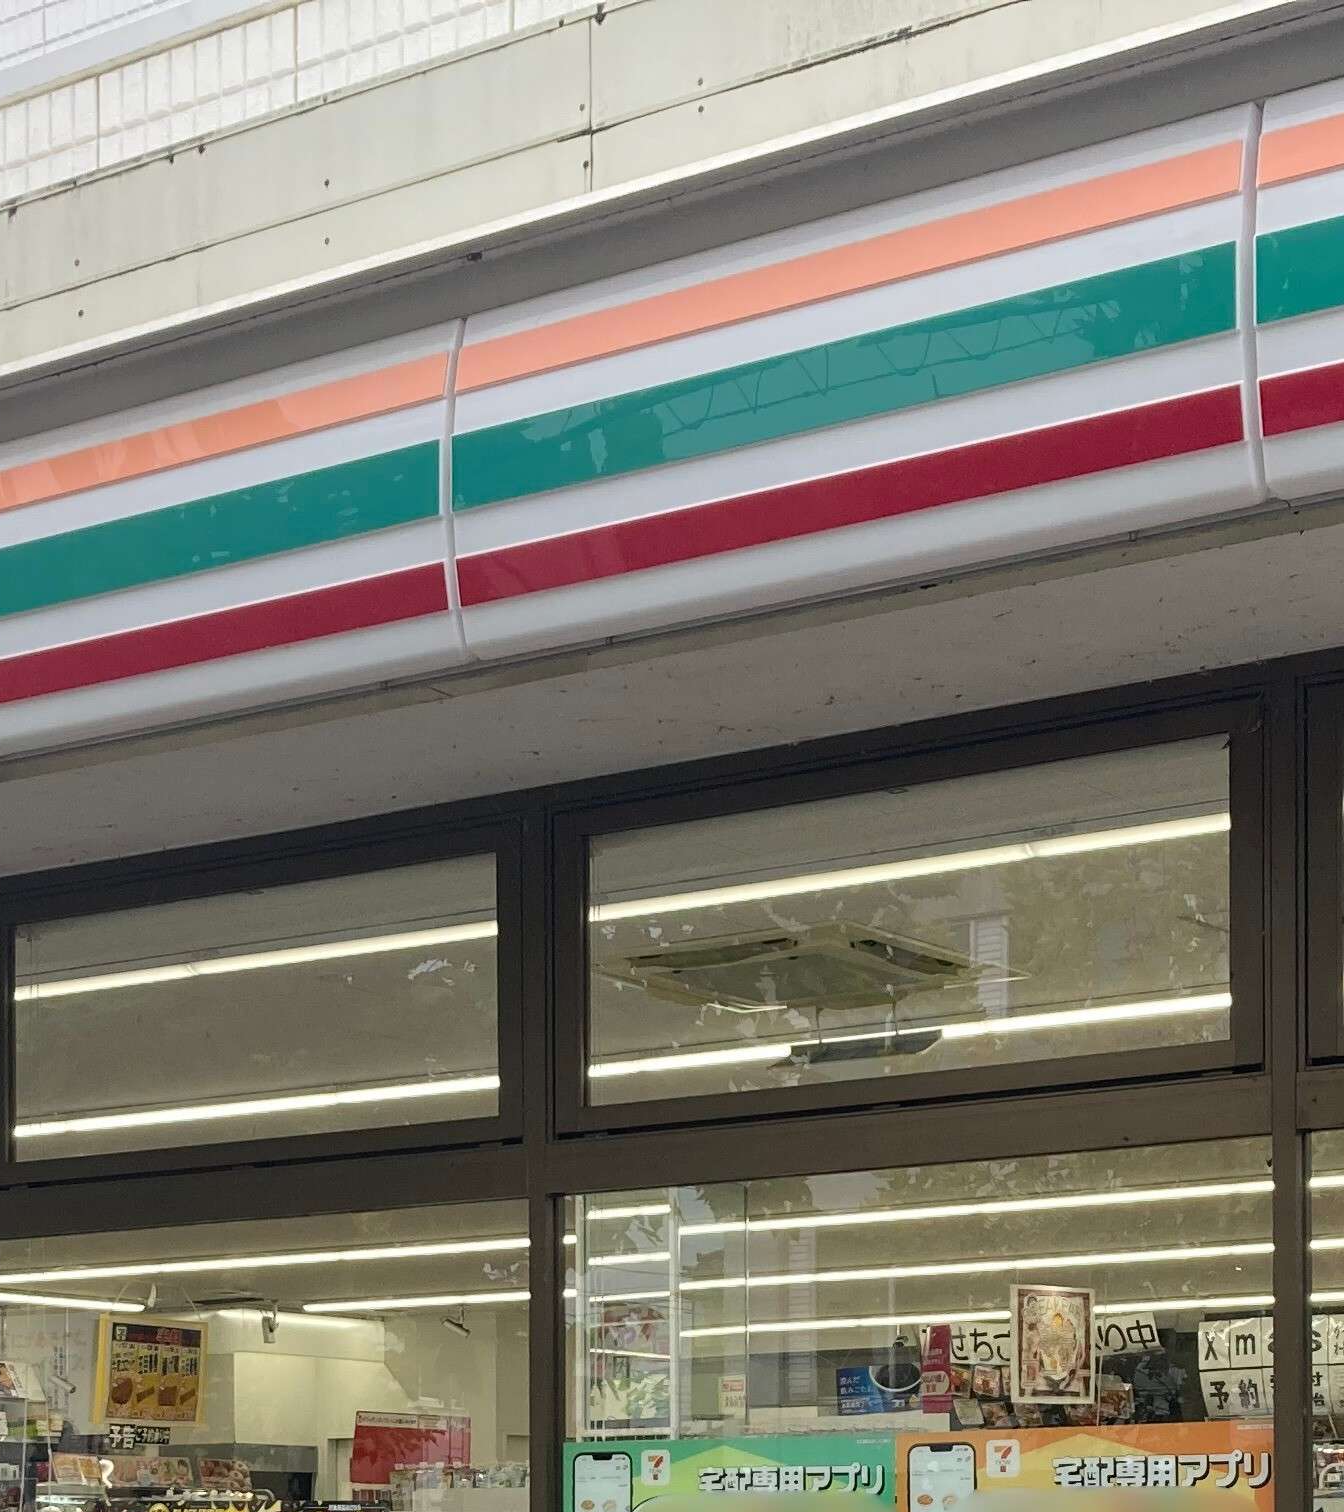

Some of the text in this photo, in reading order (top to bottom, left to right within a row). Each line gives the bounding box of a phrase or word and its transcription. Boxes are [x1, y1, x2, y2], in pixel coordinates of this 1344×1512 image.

[1053, 1448, 1272, 1491] 宅配専用アプリ
